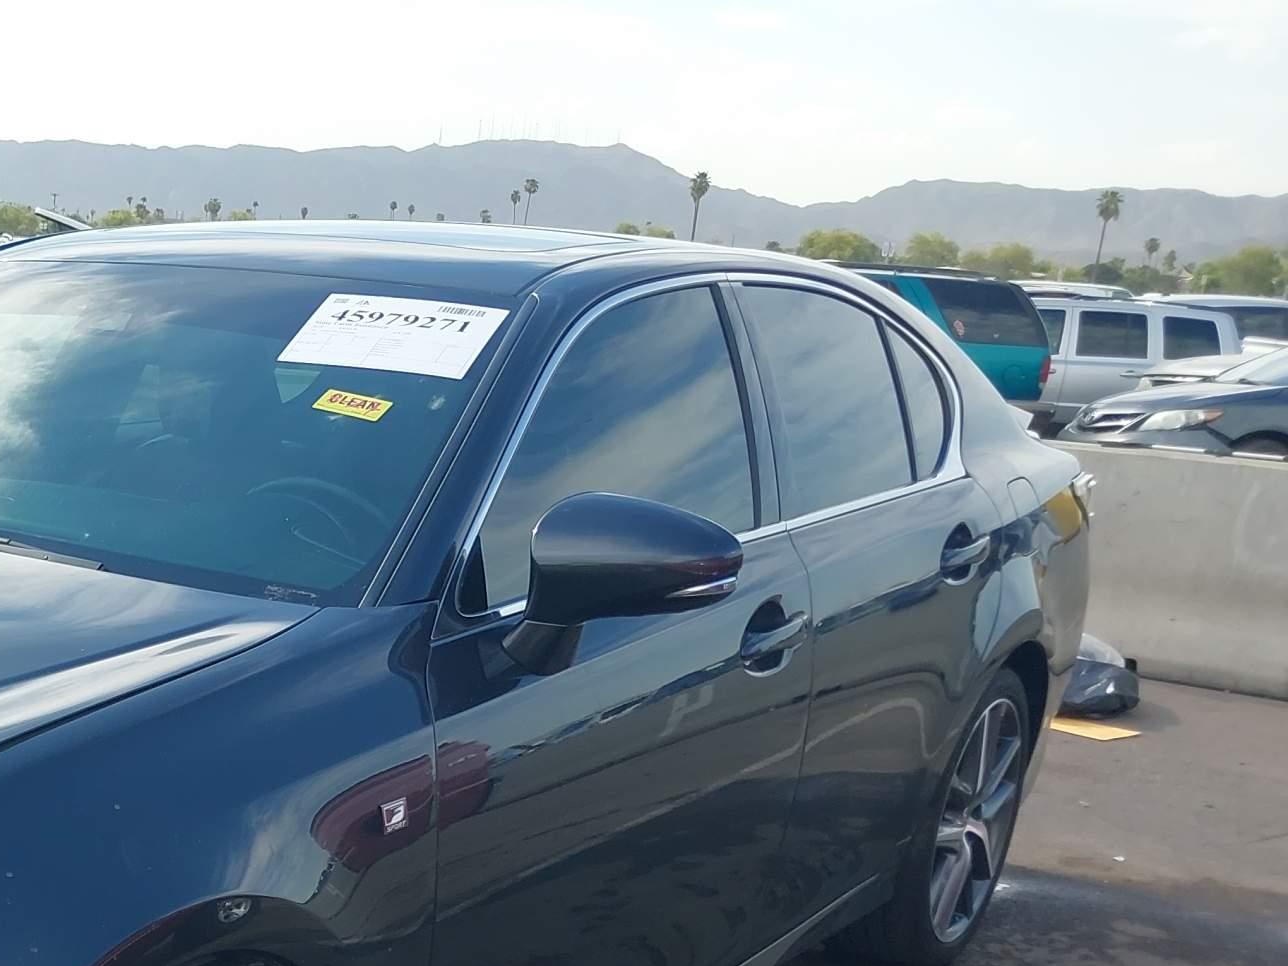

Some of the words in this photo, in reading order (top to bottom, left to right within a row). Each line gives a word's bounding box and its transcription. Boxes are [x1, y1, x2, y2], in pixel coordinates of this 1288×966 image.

[330, 308, 472, 333] 45979271
[328, 393, 381, 410] CLEAN
[386, 820, 407, 833] SPORT
